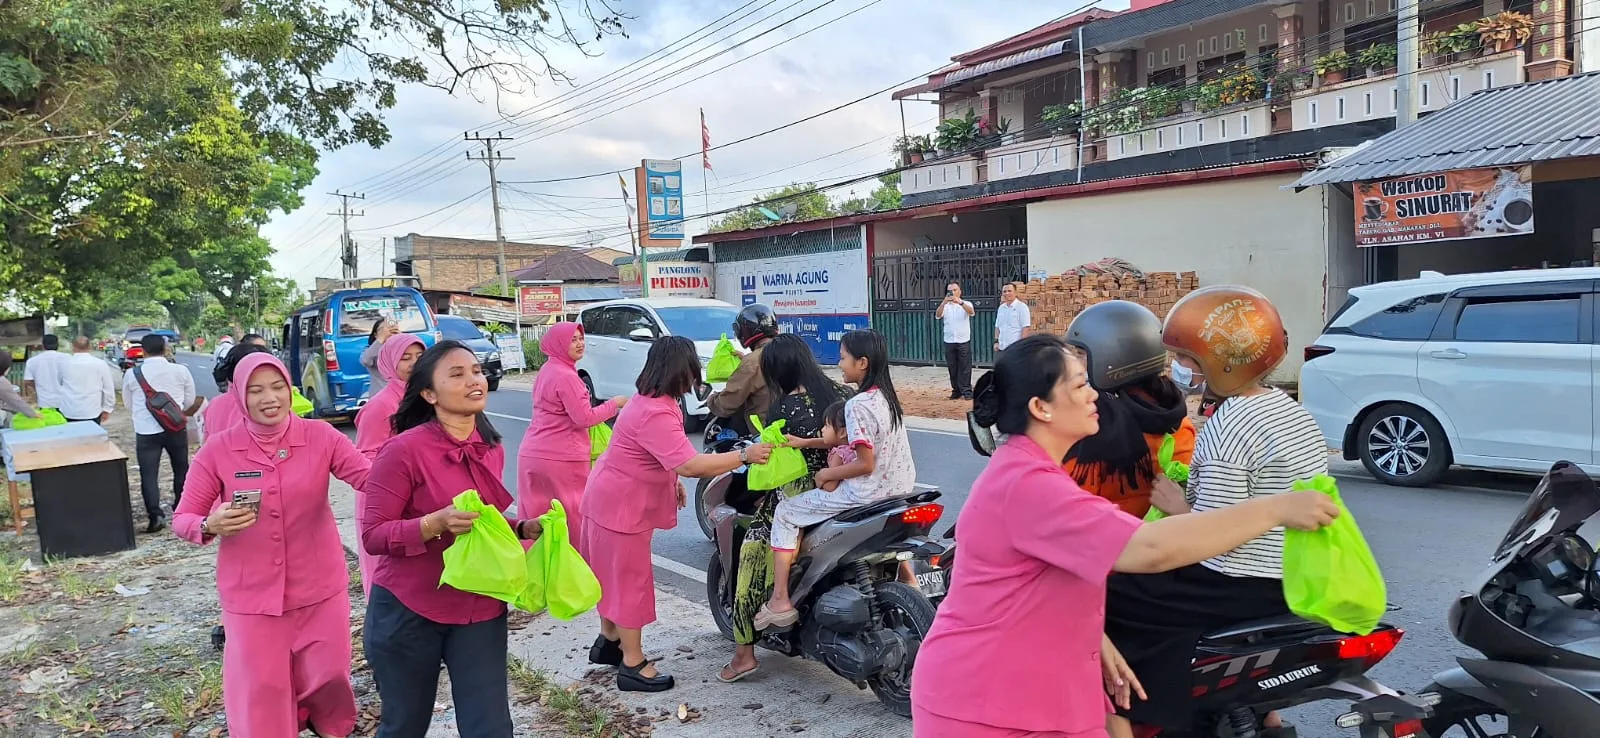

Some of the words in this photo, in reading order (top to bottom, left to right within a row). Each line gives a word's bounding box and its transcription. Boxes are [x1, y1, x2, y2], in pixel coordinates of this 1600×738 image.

[1396, 192, 1473, 218] SINURAT
[1382, 234, 1415, 243] ASAHAN
[658, 266, 701, 275] PANGLONG
[650, 276, 709, 289] PURSIDA
[762, 272, 794, 287] WARNA
[795, 270, 829, 285] AGUNG
[1257, 664, 1323, 691] SIDAURUK
